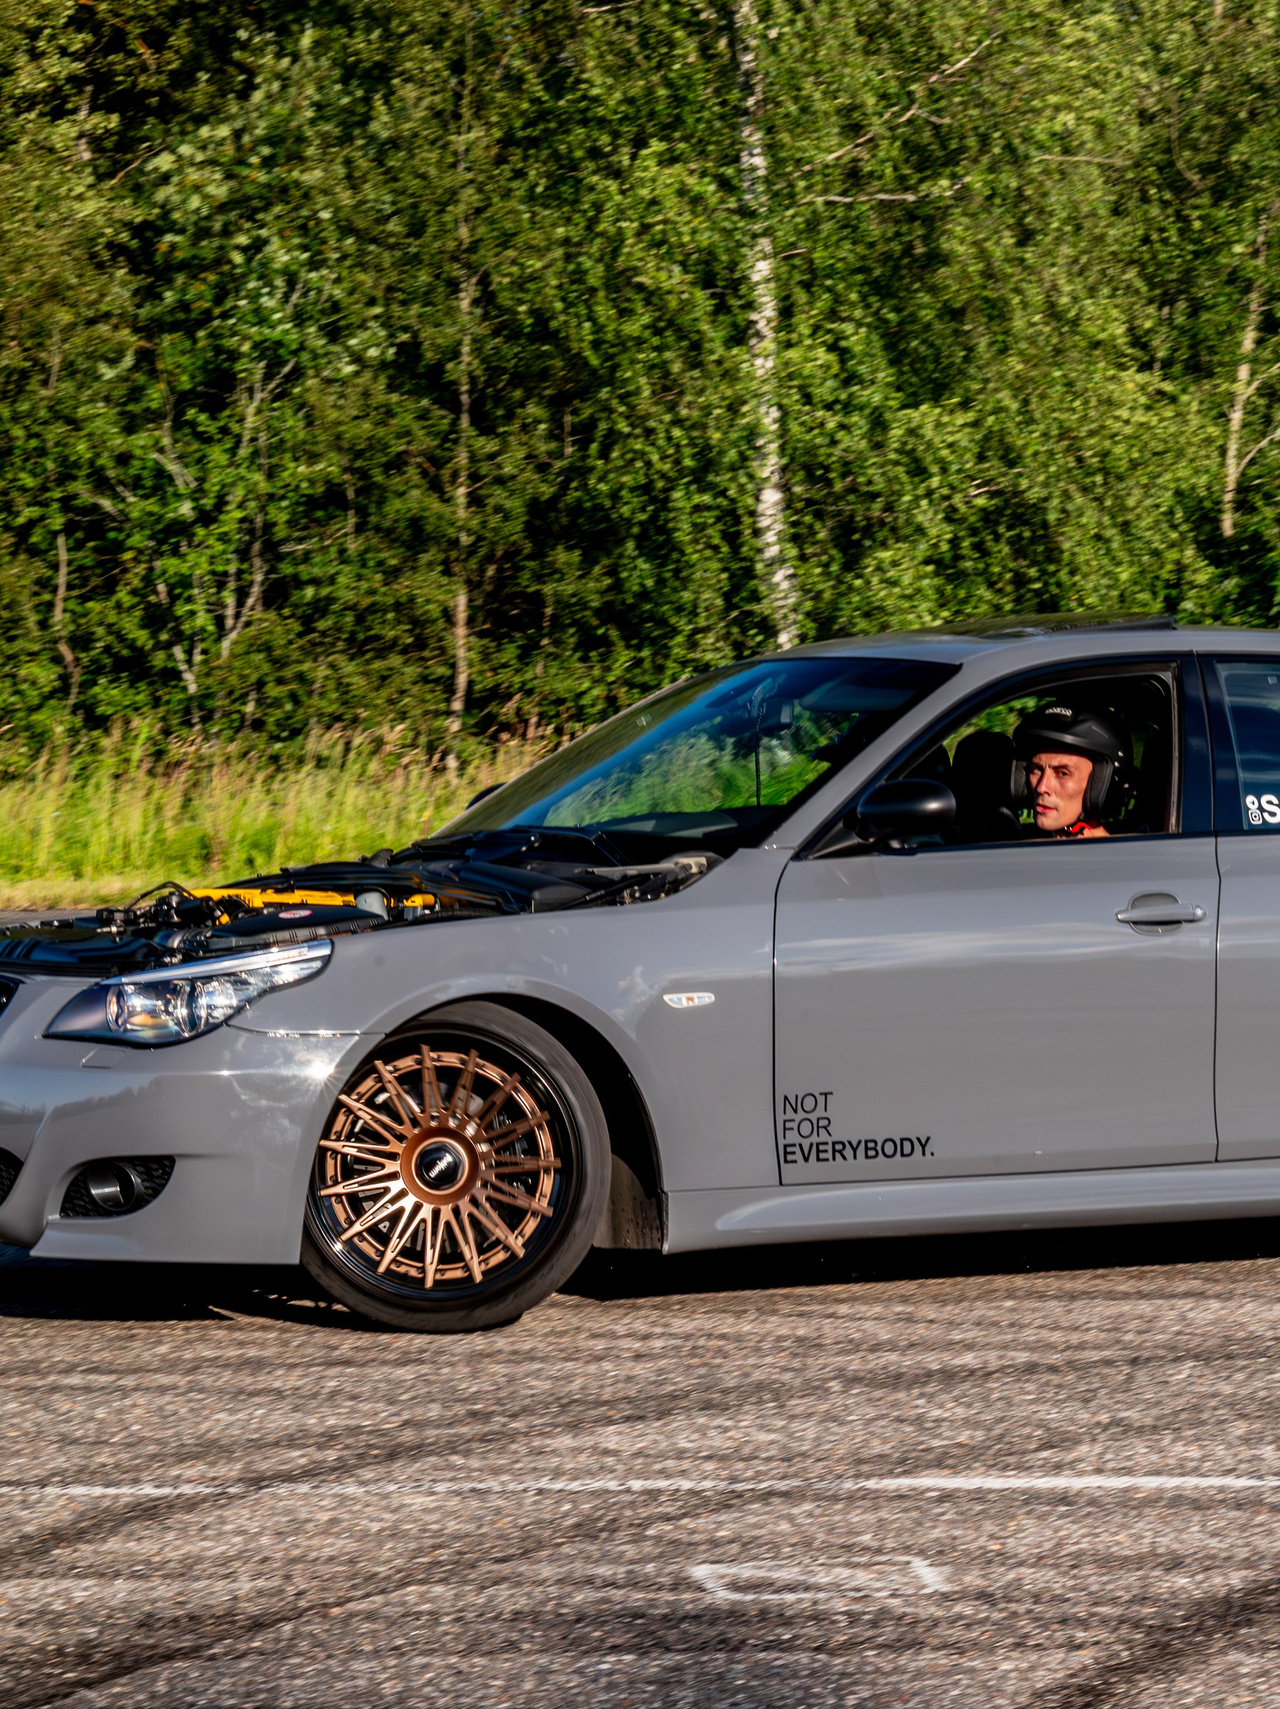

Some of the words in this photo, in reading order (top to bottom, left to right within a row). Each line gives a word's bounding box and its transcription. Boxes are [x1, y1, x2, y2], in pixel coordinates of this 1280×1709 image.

[783, 1092, 834, 1115] NOT
[783, 1117, 832, 1140] FOR
[783, 1136, 935, 1164] EVERYBODY.
